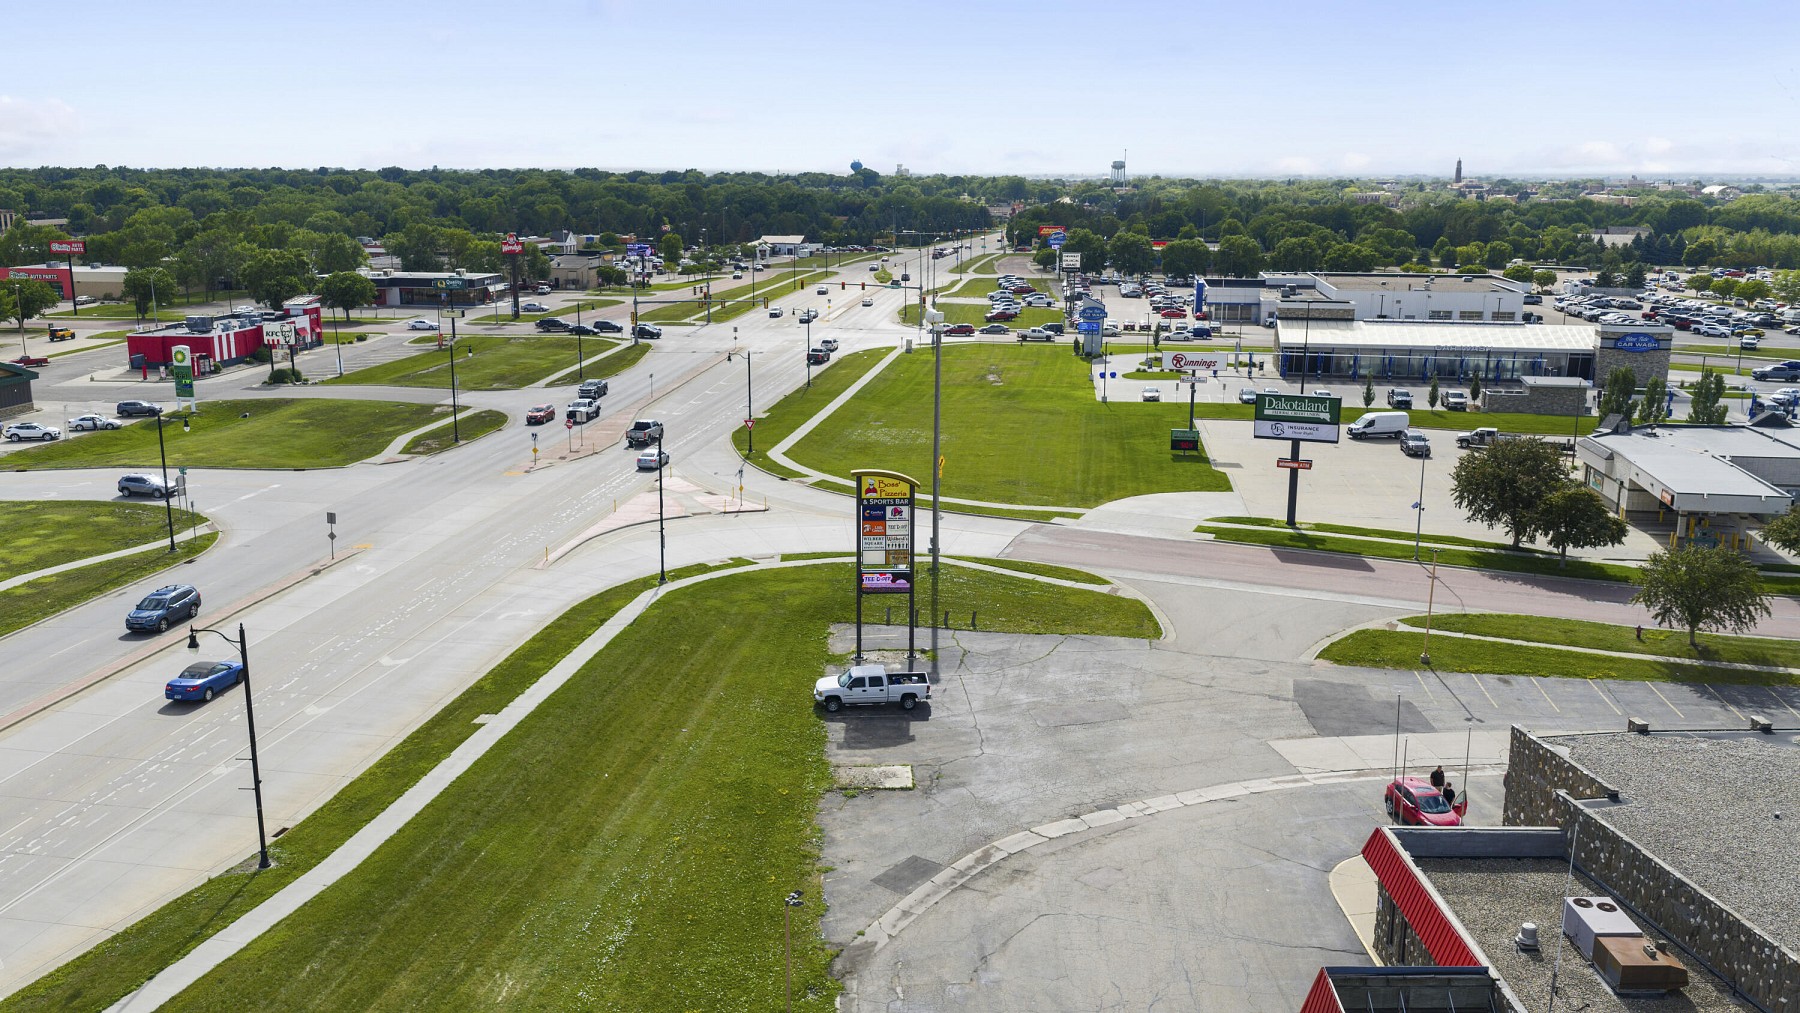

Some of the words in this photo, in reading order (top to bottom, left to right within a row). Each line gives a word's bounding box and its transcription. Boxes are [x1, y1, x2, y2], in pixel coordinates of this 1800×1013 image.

[1172, 354, 1218, 368] Runnings
[1265, 396, 1329, 412] Dakotaland
[878, 480, 900, 488] Boss'
[880, 489, 907, 497] Pizzeria
